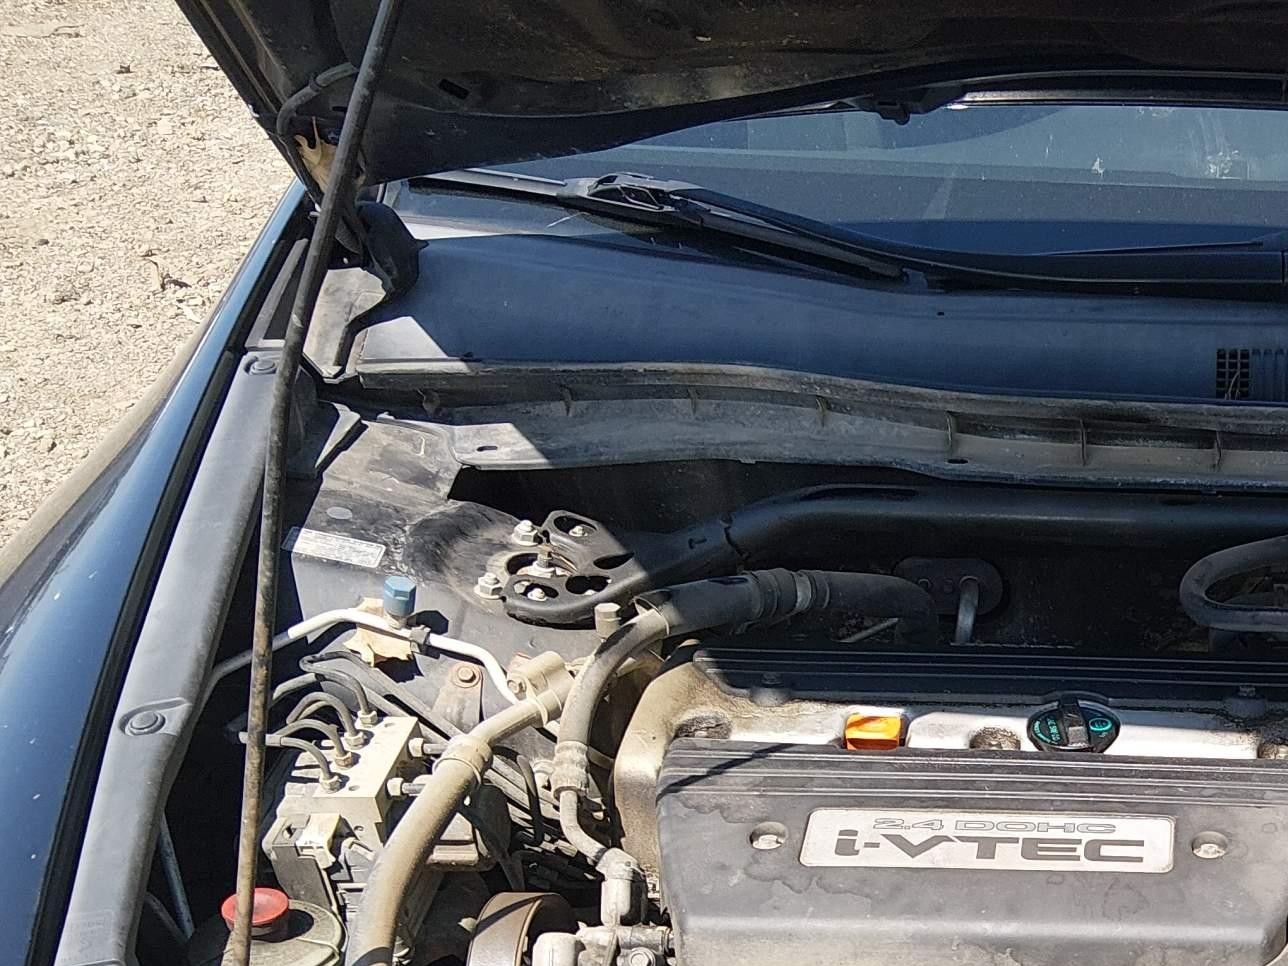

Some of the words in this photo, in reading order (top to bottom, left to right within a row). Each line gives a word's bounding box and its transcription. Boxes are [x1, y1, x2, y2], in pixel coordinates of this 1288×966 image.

[872, 817, 945, 832] 2.4
[953, 820, 1117, 835] DOHC
[834, 829, 1145, 864] i-VTEC
